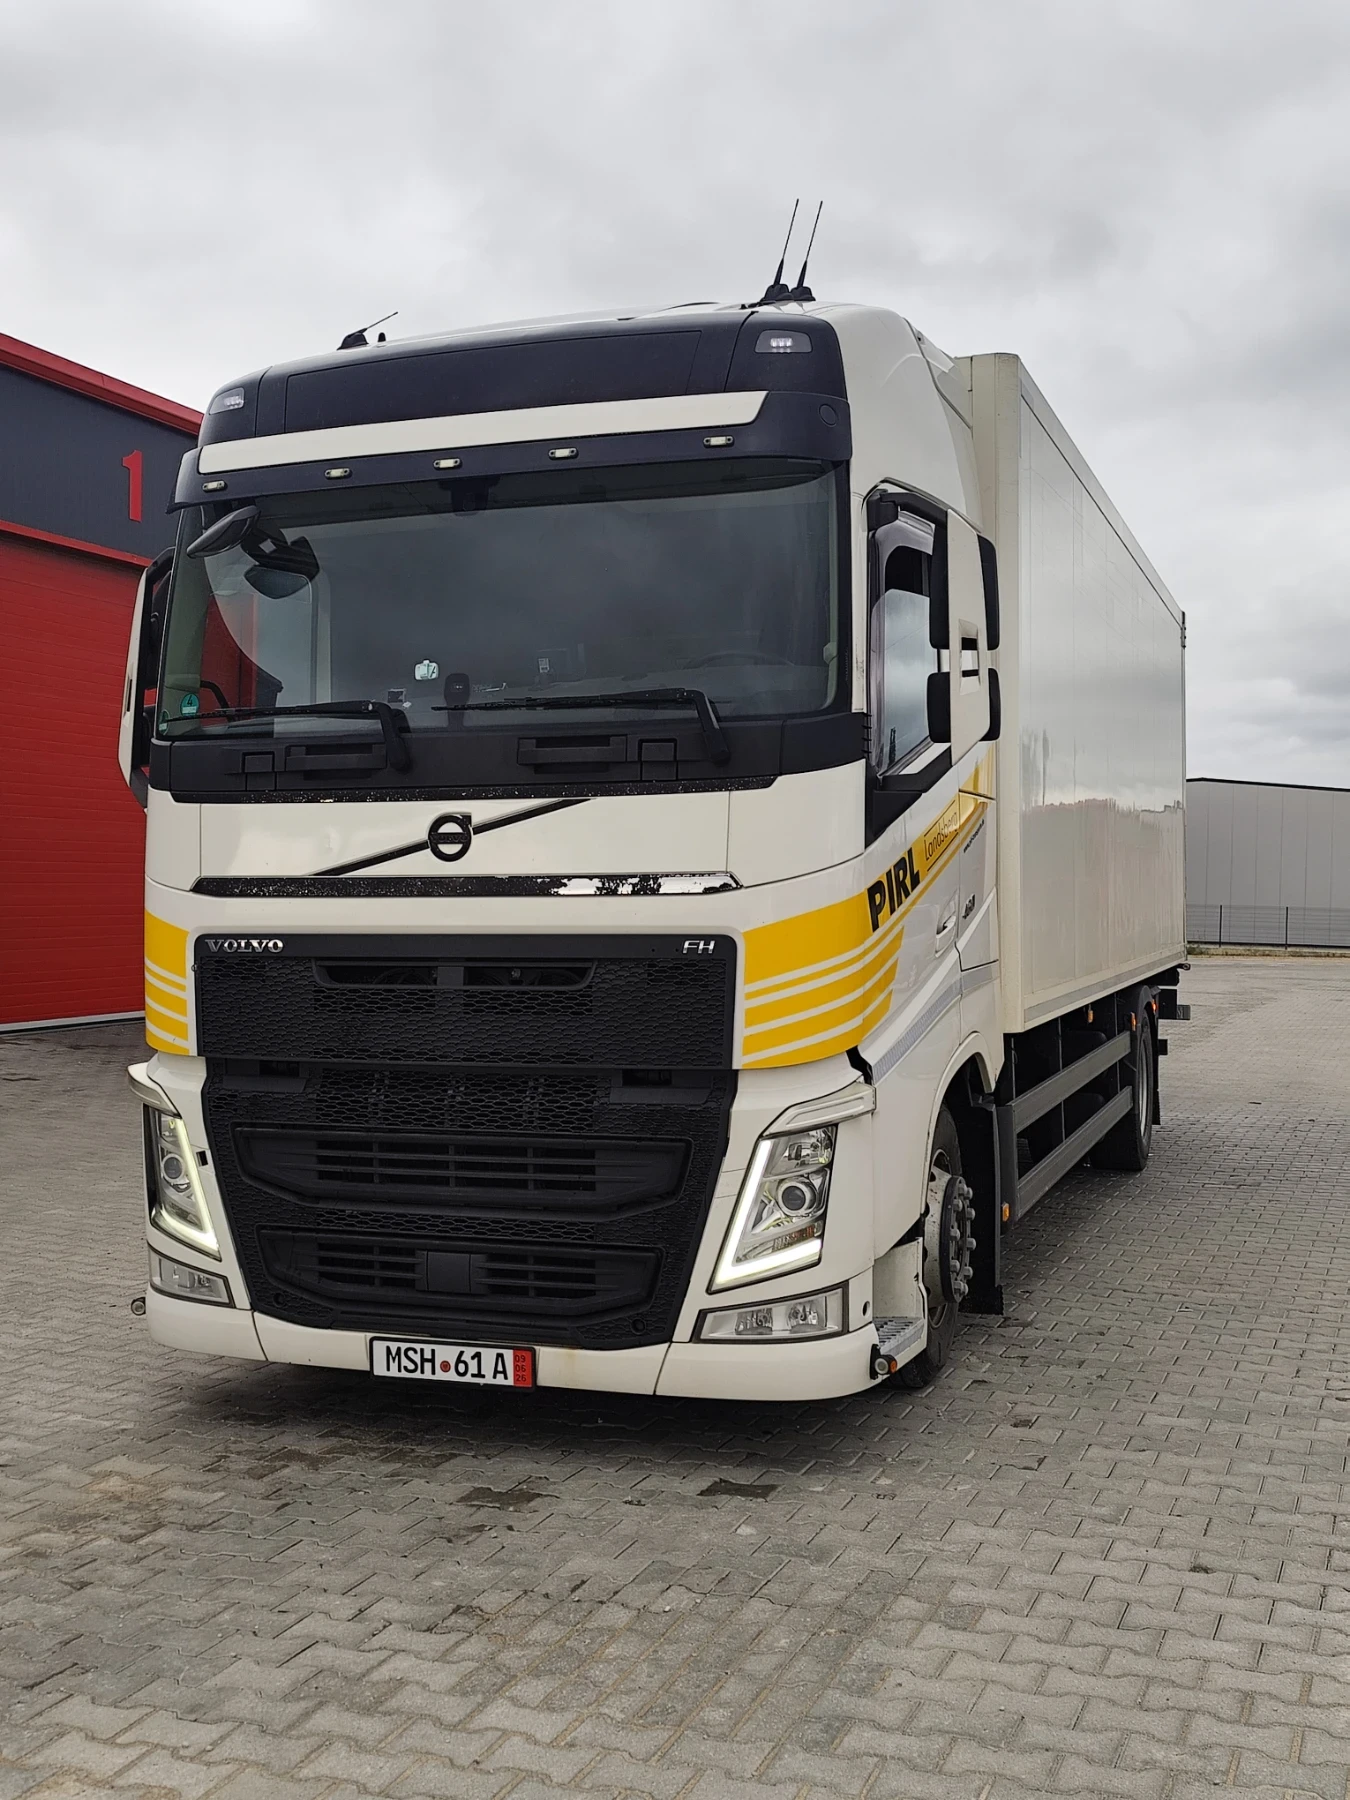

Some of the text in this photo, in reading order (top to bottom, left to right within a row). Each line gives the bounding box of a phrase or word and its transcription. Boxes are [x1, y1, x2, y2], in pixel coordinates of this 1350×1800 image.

[122, 450, 142, 523] 1
[187, 694, 194, 706] 4
[867, 847, 921, 933] PIRL
[205, 939, 284, 953] VOLVO
[682, 940, 716, 954] FH
[385, 1345, 436, 1376] MSH
[514, 1354, 526, 1363] 09
[515, 1364, 527, 1372] 06
[516, 1374, 527, 1382] 26
